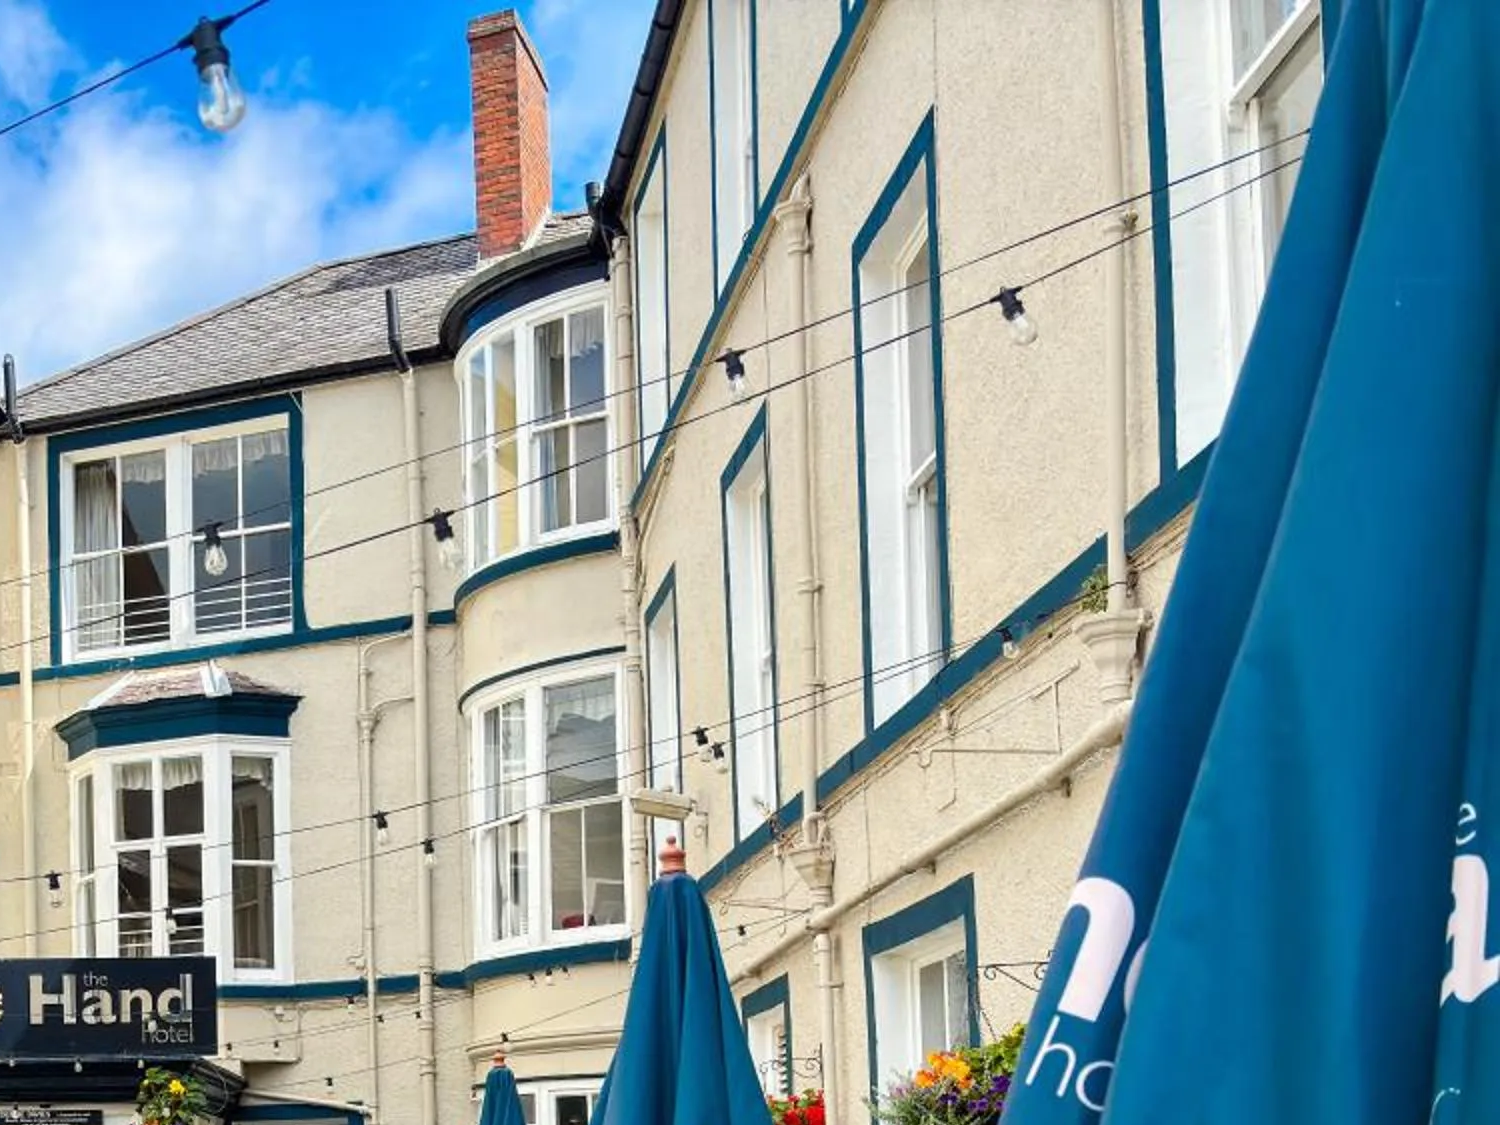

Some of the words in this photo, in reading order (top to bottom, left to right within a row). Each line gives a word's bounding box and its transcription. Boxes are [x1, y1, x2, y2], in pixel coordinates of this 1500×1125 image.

[83, 971, 108, 987] the
[29, 973, 193, 1025] Hand
[141, 1019, 194, 1044] hotel
